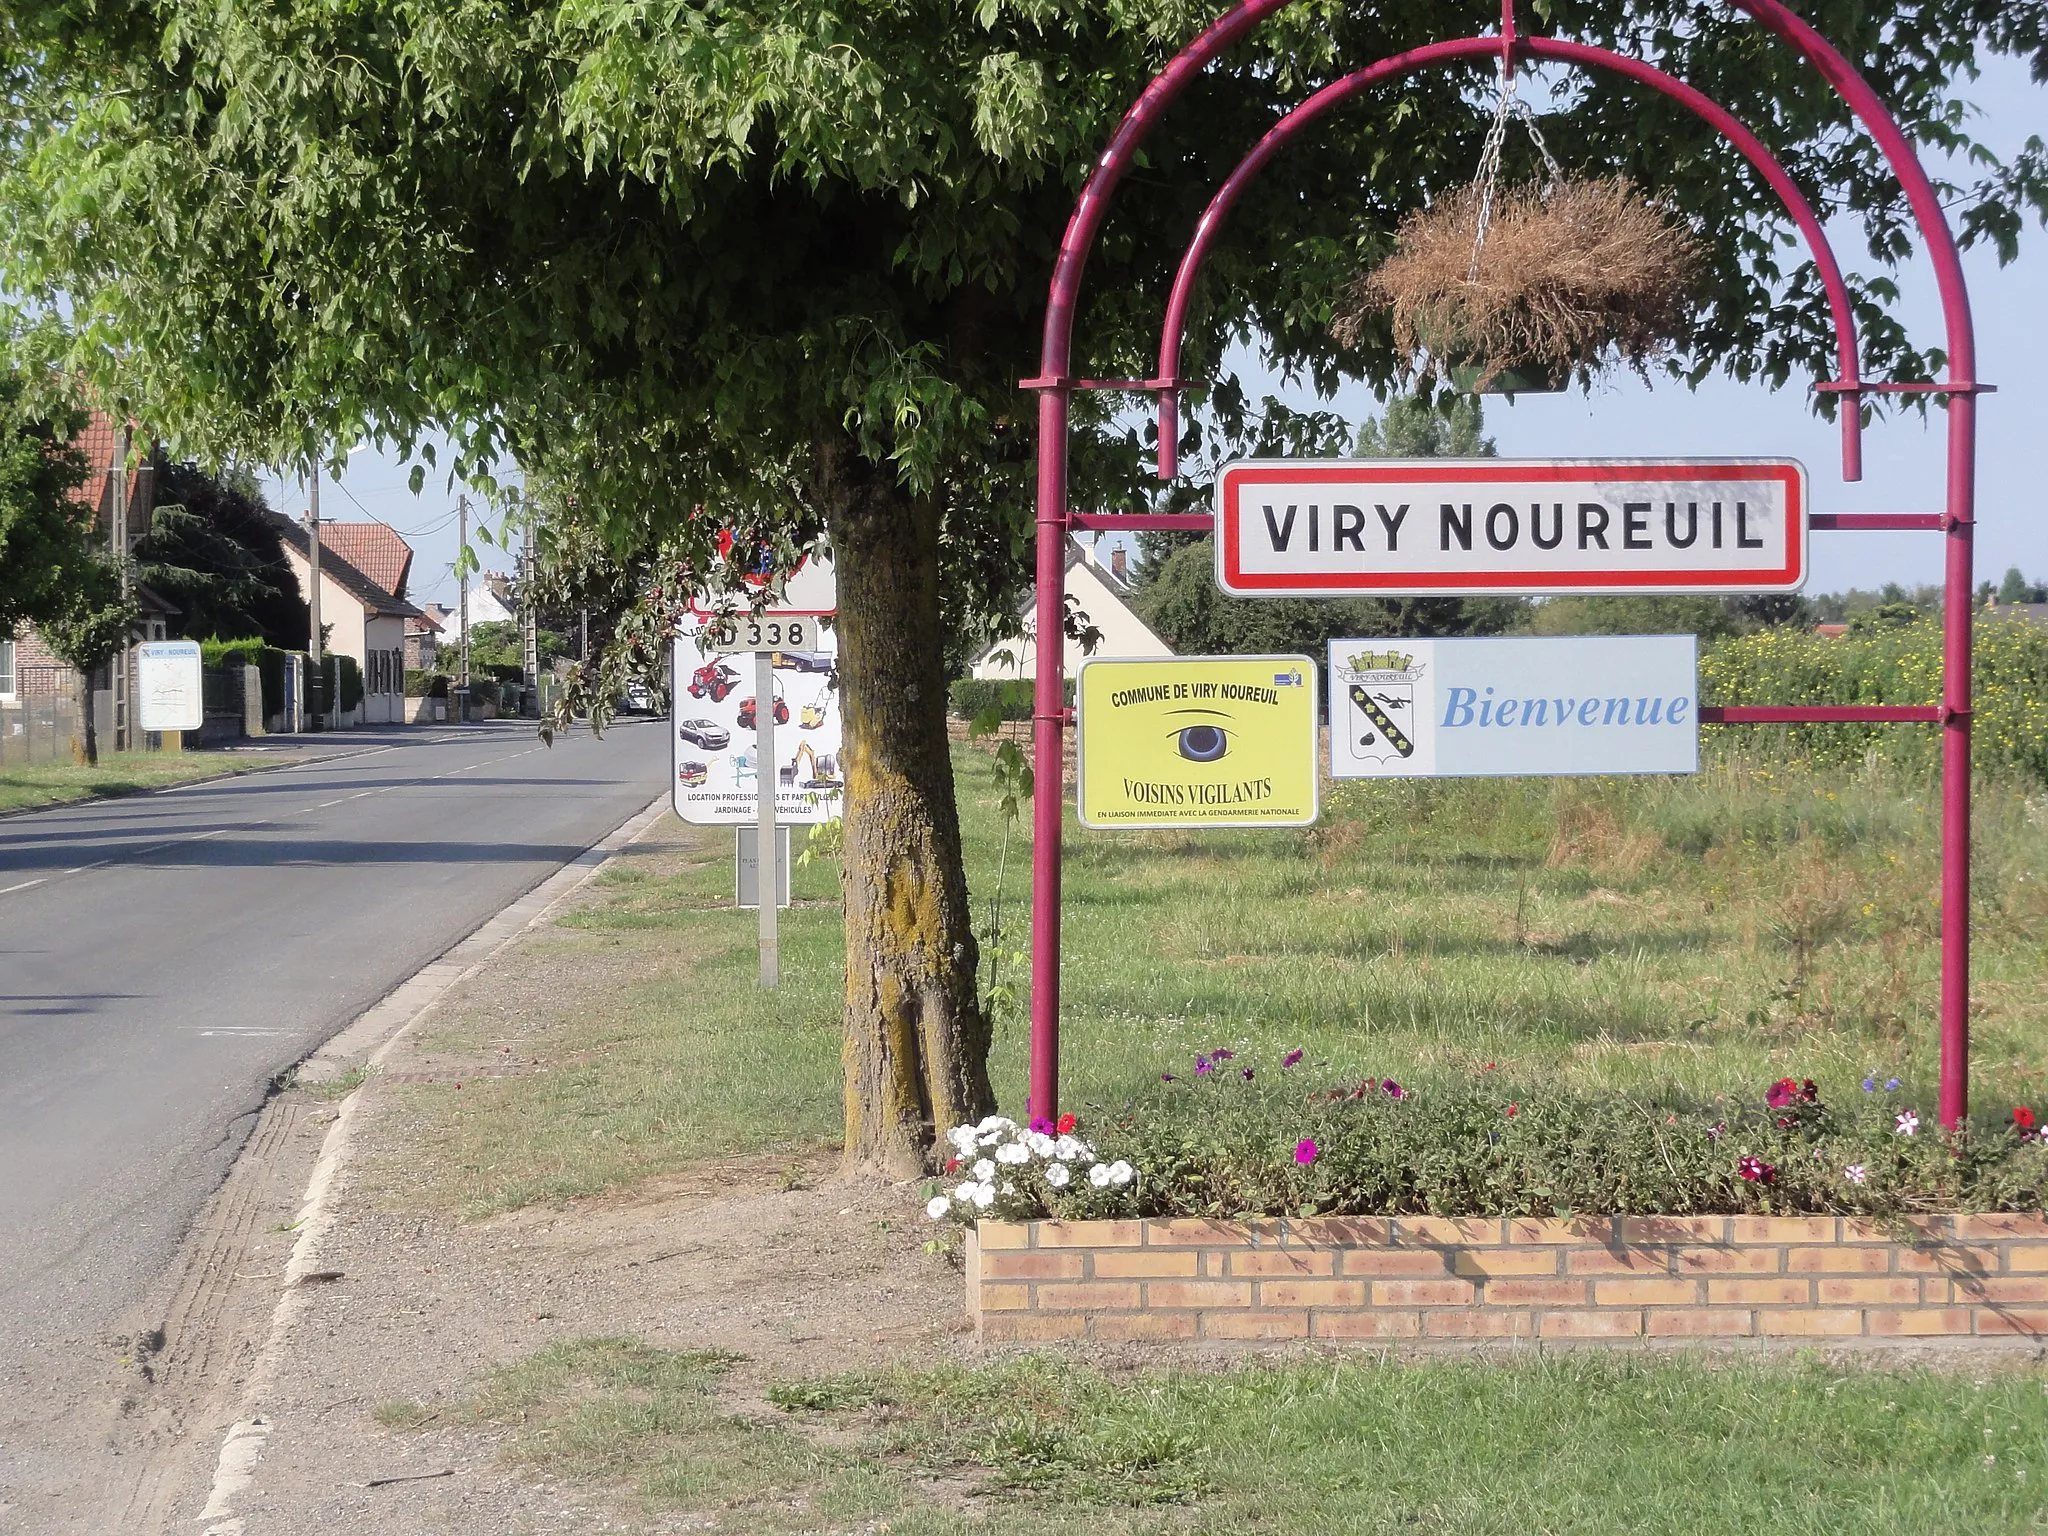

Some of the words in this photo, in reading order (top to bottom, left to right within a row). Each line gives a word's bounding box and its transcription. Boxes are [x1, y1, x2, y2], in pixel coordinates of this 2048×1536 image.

[1262, 504, 1410, 552] VIRY
[1440, 502, 1763, 550] NOUREUIL
[720, 623, 736, 645] D
[747, 623, 803, 645] 338
[1111, 685, 1170, 708] COMMUNE
[1174, 683, 1188, 698] DE
[1191, 683, 1218, 698] VIRY
[1221, 684, 1279, 705] NOUREUIL
[1440, 686, 1690, 727] Bienvenue
[687, 793, 721, 801] LOCATION
[782, 793, 789, 801] ET
[1123, 778, 1184, 805] VOISINS
[1188, 777, 1271, 805] VIGILANTS
[714, 806, 752, 814] JARDINAGE
[1137, 810, 1177, 818] IMMEDIATE
[1208, 809, 1259, 817] GENDARMERIE
[1260, 808, 1300, 816] NATIONALE
